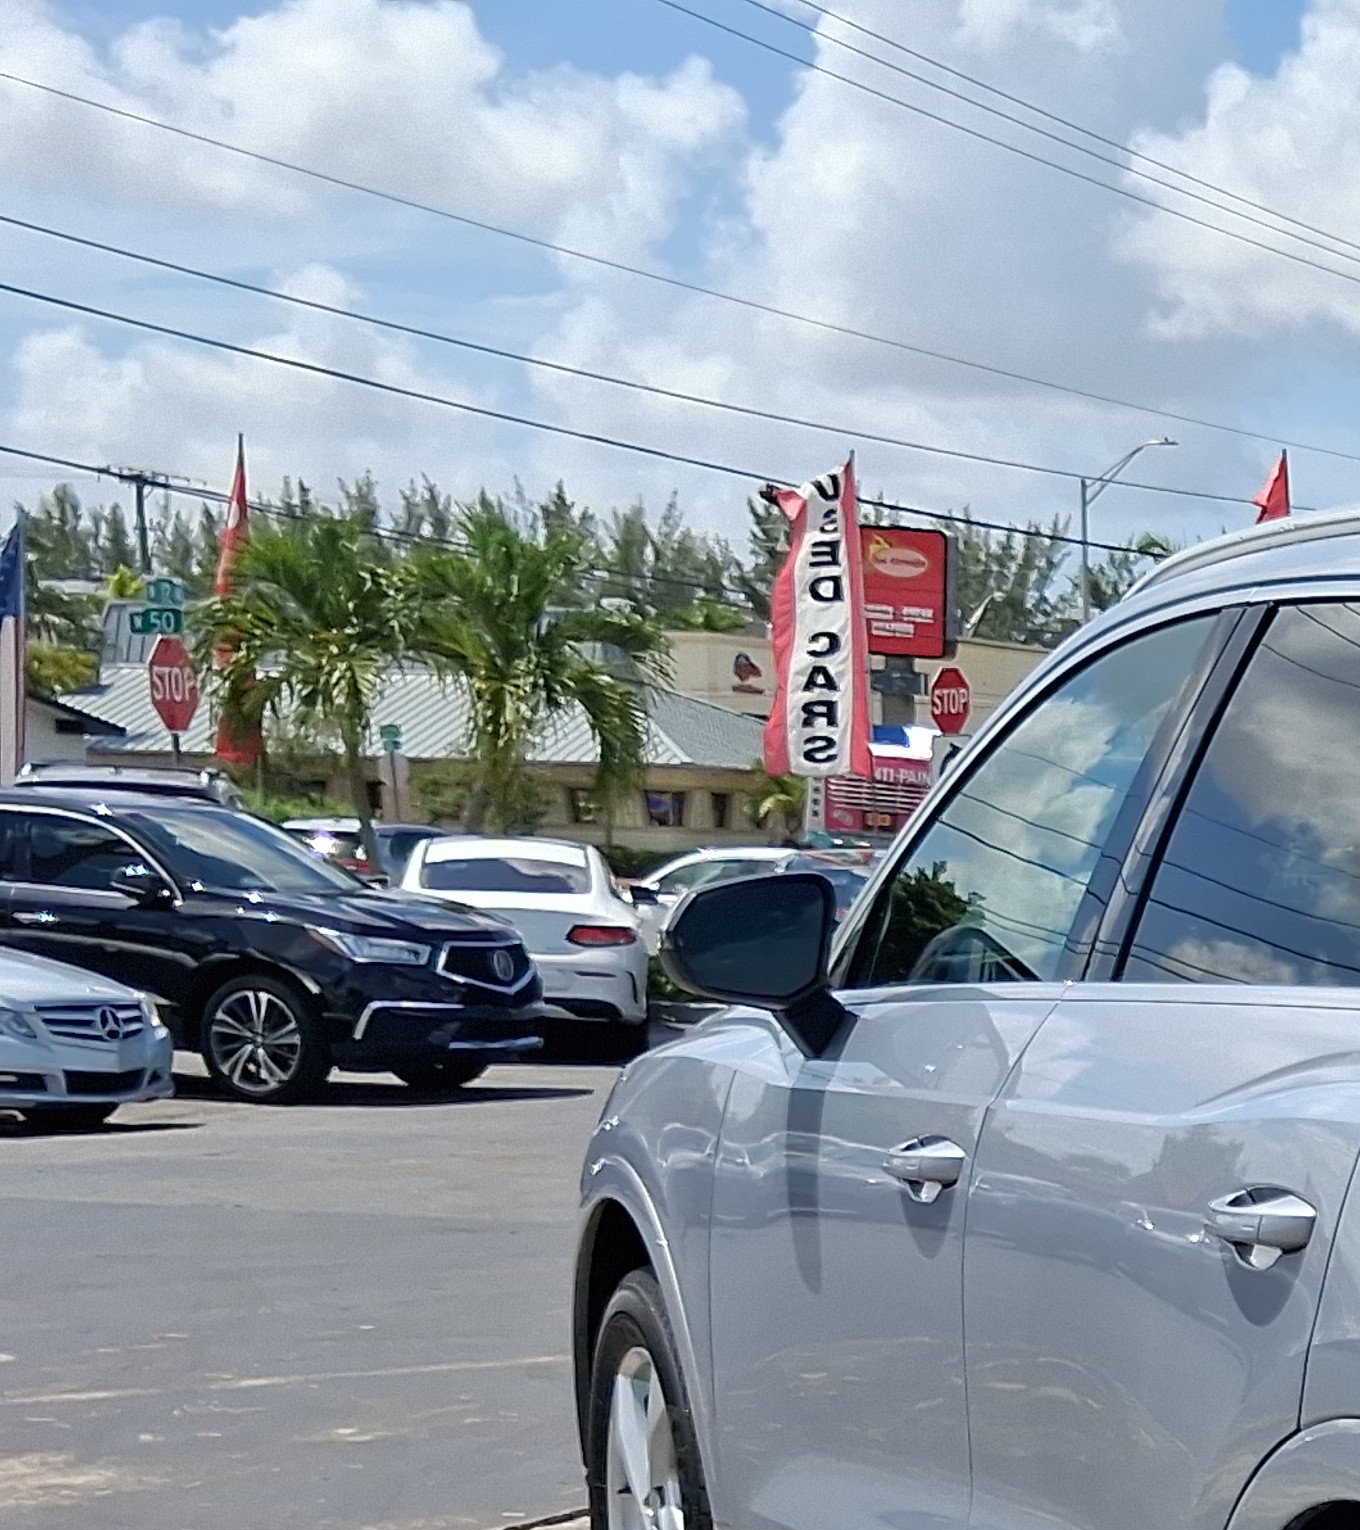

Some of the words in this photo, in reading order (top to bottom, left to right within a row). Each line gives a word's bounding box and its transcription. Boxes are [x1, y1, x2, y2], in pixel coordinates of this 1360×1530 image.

[150, 611, 175, 633] 50
[152, 666, 196, 702] STOP
[932, 689, 969, 716] STOP
